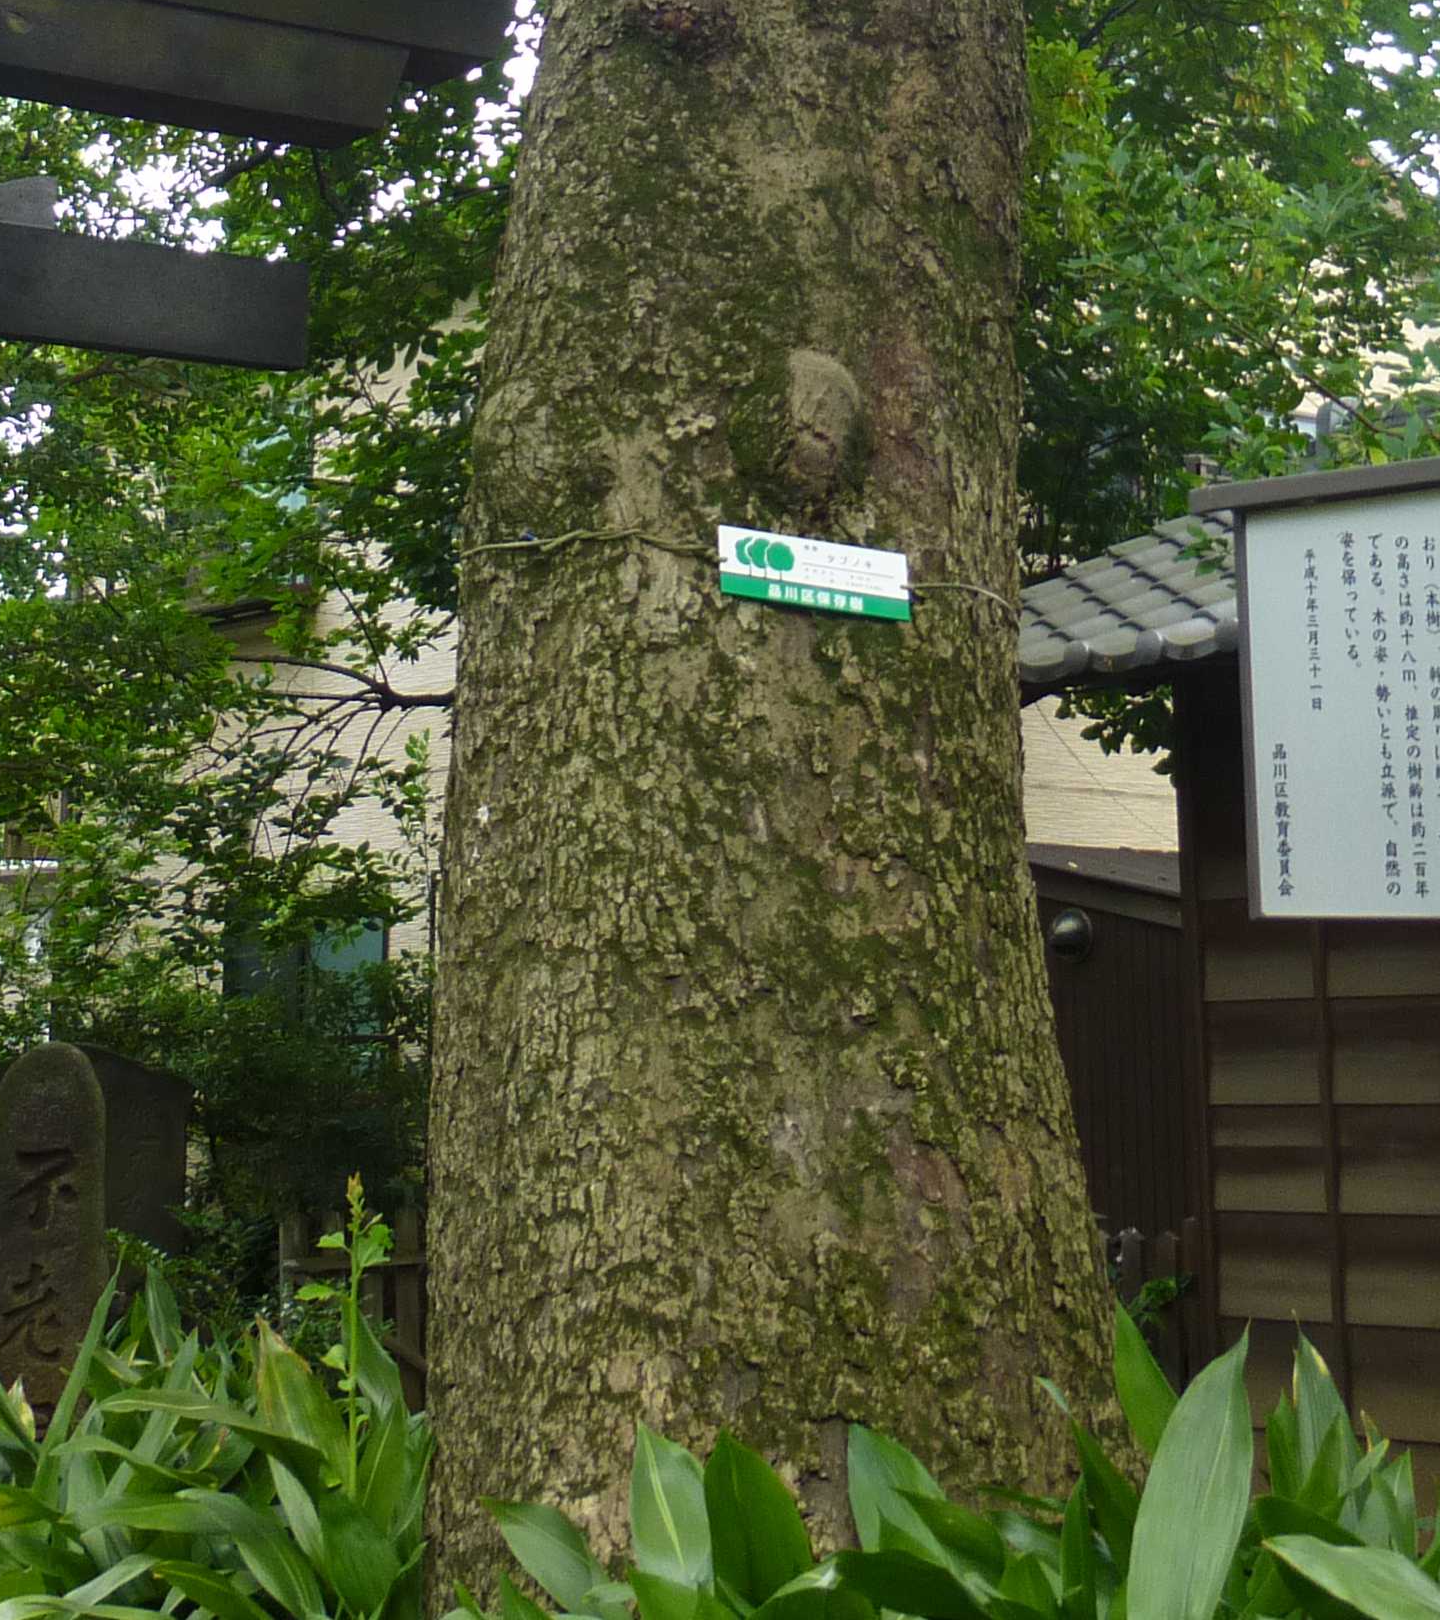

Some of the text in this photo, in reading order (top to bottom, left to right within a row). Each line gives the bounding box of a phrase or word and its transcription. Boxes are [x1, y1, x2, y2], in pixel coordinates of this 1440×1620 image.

[768, 584, 864, 613] 品川区保存樹
[1304, 549, 1322, 711] 平成十年三月三十一日
[1338, 531, 1361, 667] 姿を保っている。
[1272, 743, 1295, 897] 品川区教育委員会
